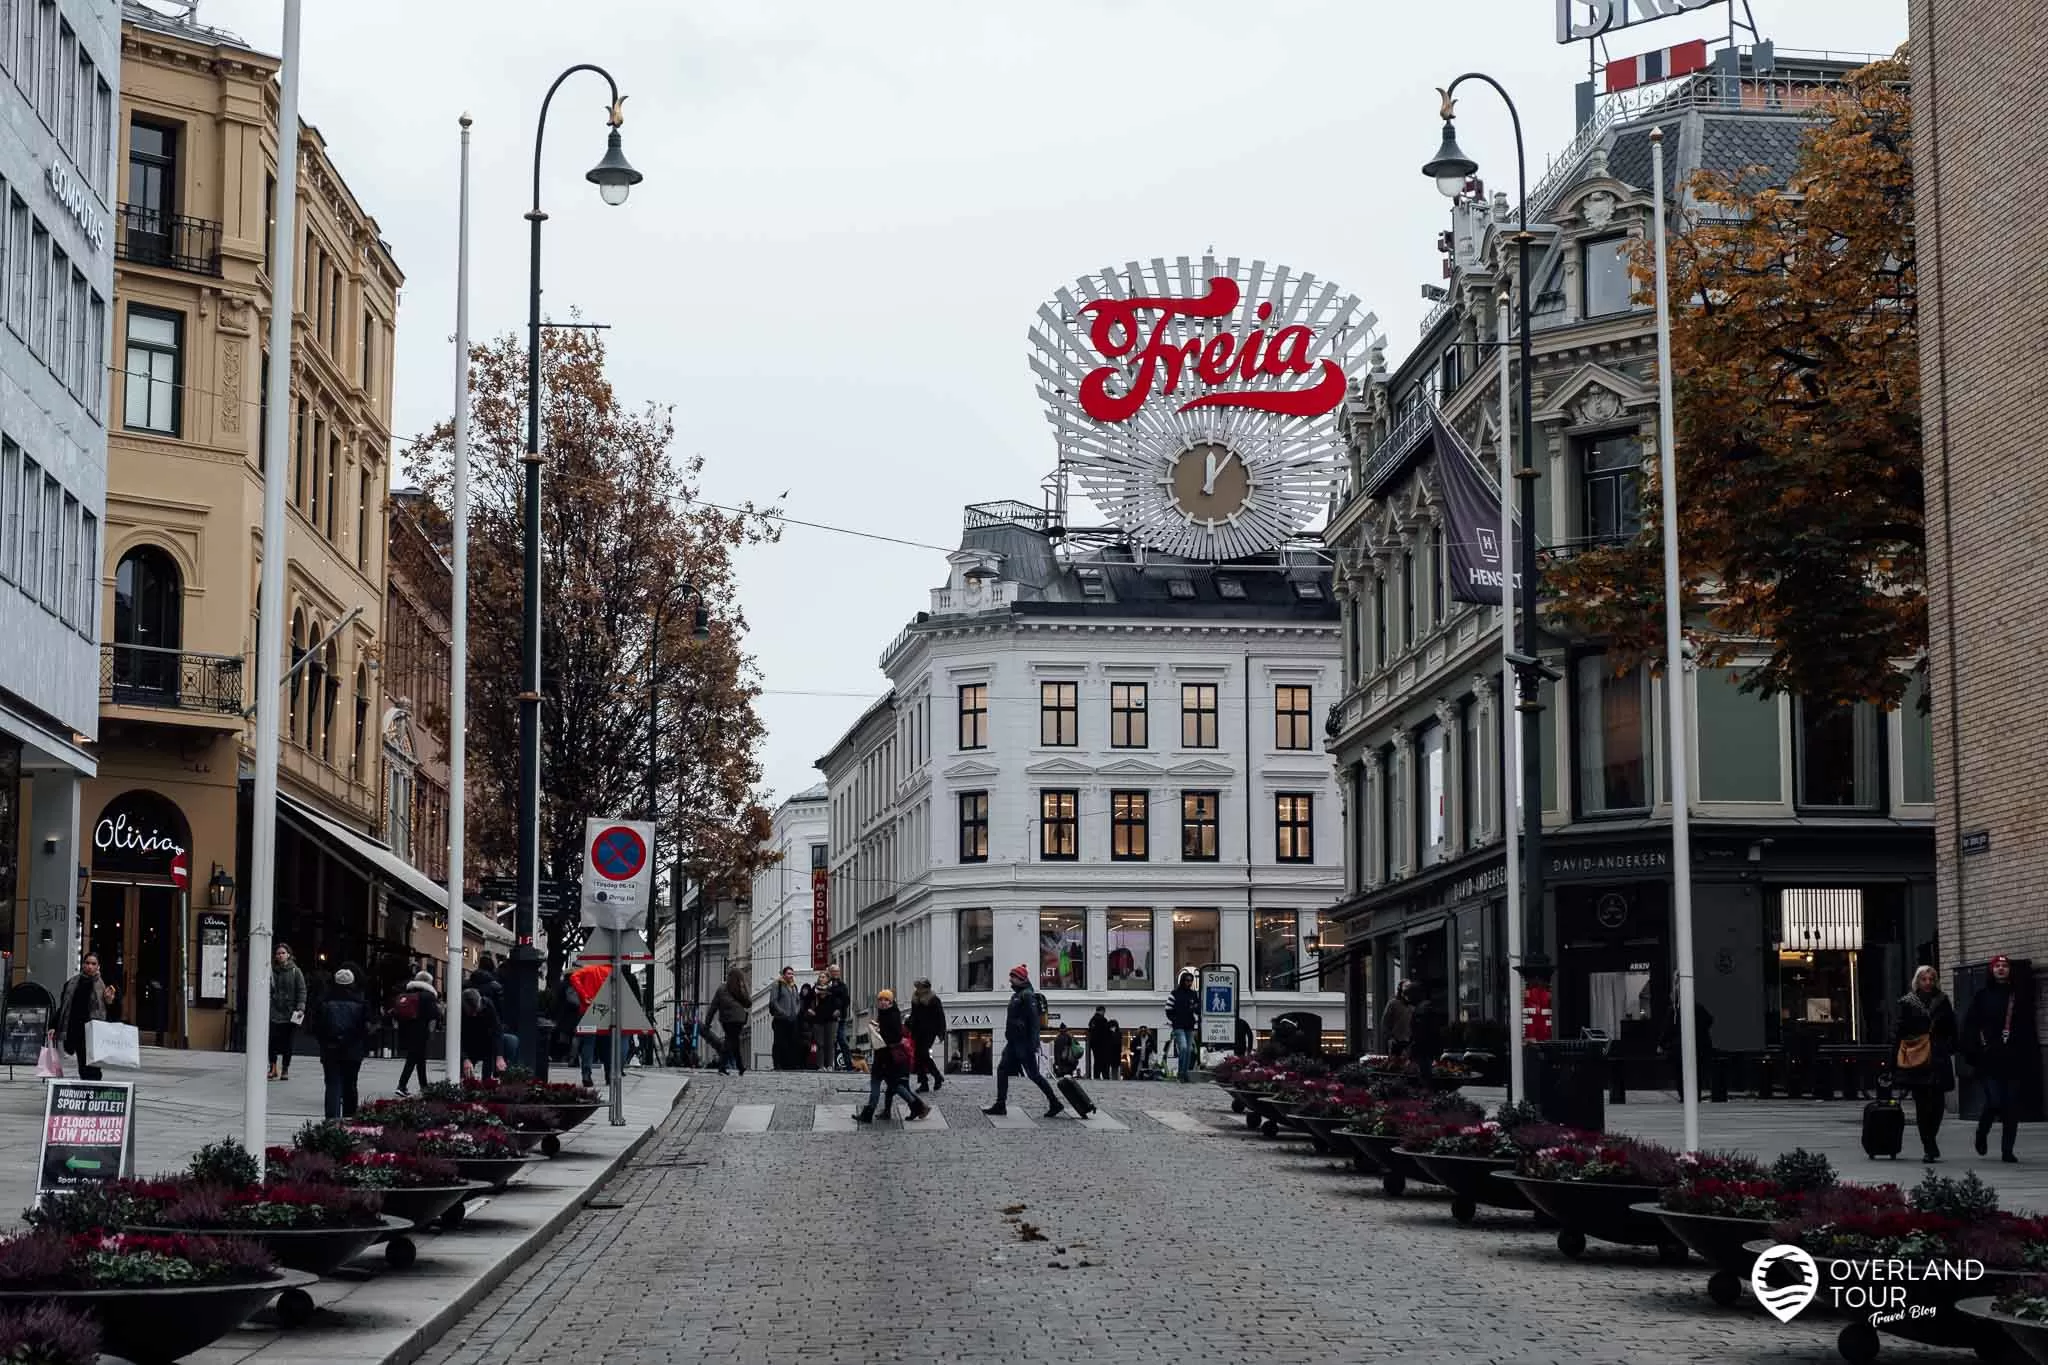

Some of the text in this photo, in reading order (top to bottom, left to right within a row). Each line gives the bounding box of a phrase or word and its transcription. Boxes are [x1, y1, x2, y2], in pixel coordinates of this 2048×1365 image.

[52, 159, 104, 251] COMPUTAS
[1077, 276, 1347, 423] Freia
[95, 813, 185, 856] Olivia
[1553, 852, 1666, 872] DAVID-ANDERSEN
[1208, 973, 1231, 983] Sone
[951, 1015, 993, 1025] ZARA
[59, 1088, 95, 1100] NORWAY'S
[57, 1098, 125, 1113] SPORT OUTLET!
[62, 1116, 97, 1128] FLOORS
[98, 1117, 123, 1129] WITH
[52, 1127, 121, 1143] LOW PRICES
